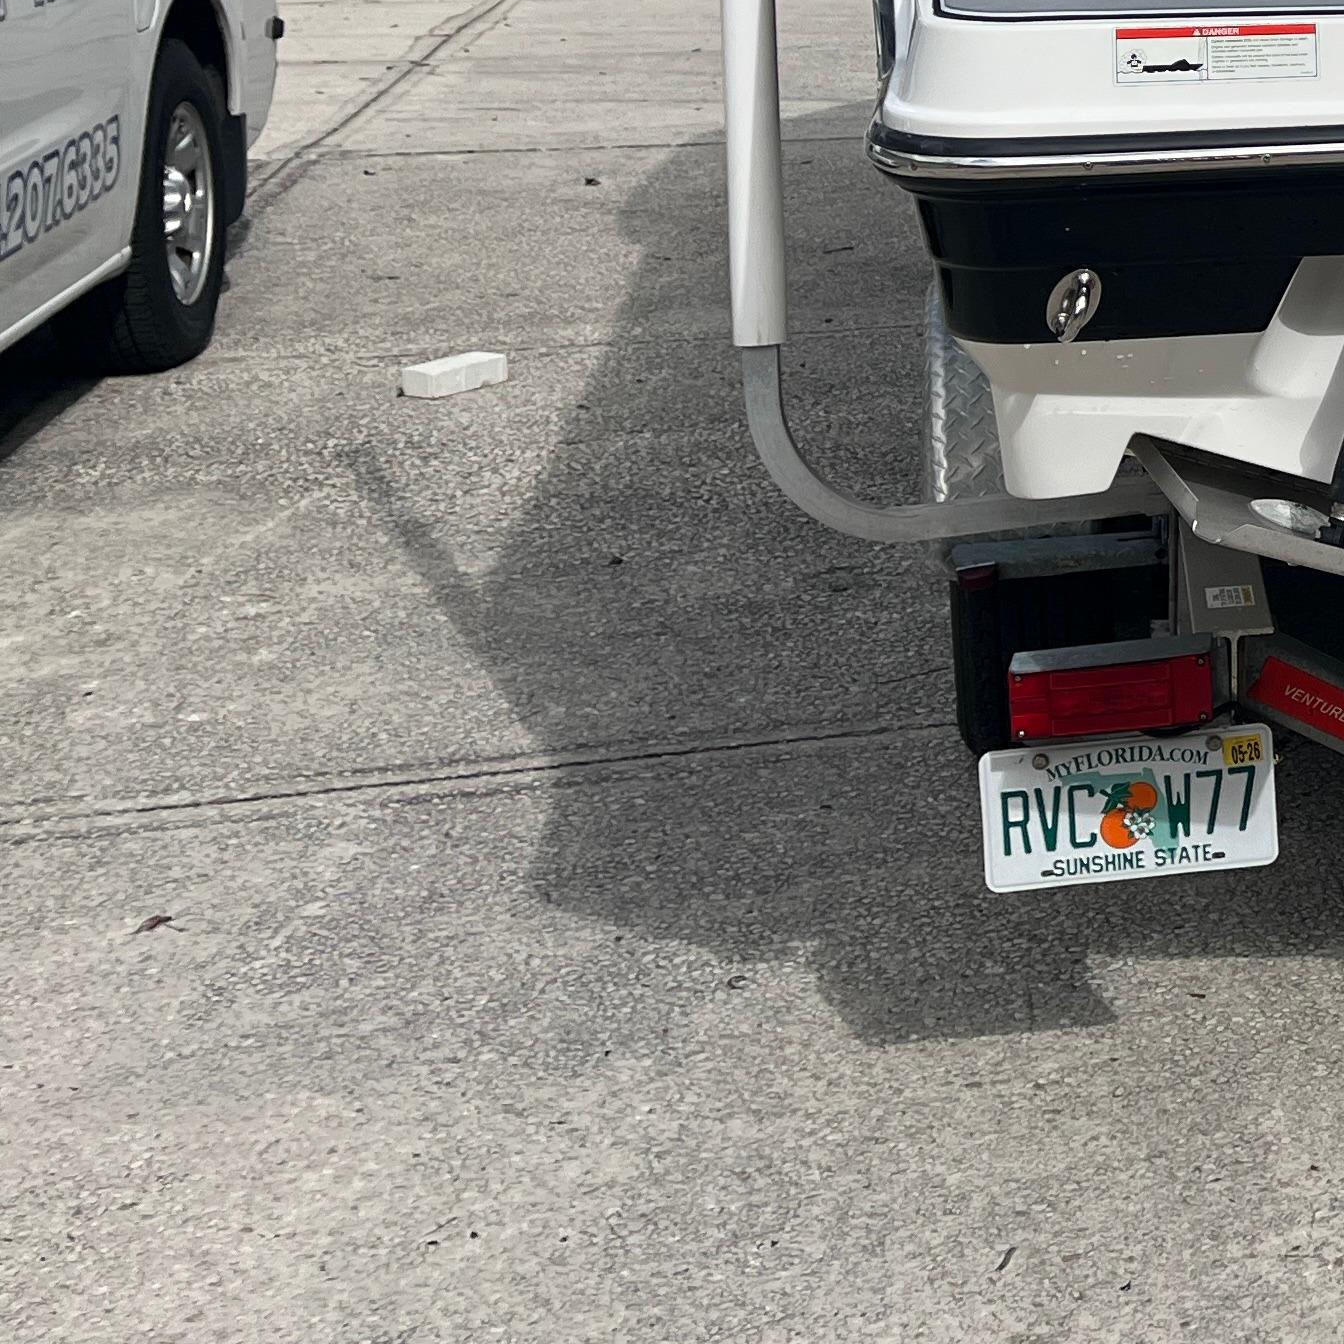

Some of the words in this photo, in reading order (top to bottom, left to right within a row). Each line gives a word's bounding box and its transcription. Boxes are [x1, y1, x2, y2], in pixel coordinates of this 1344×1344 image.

[1202, 27, 1241, 36] DANGER
[1046, 745, 1209, 782] MYFLORIDA.COM
[1231, 742, 1262, 765] 05-26
[1000, 783, 1099, 857] RVC
[1164, 765, 1256, 839] W77
[1052, 850, 1146, 877] SUNSHINE
[1155, 843, 1213, 868] STATE
